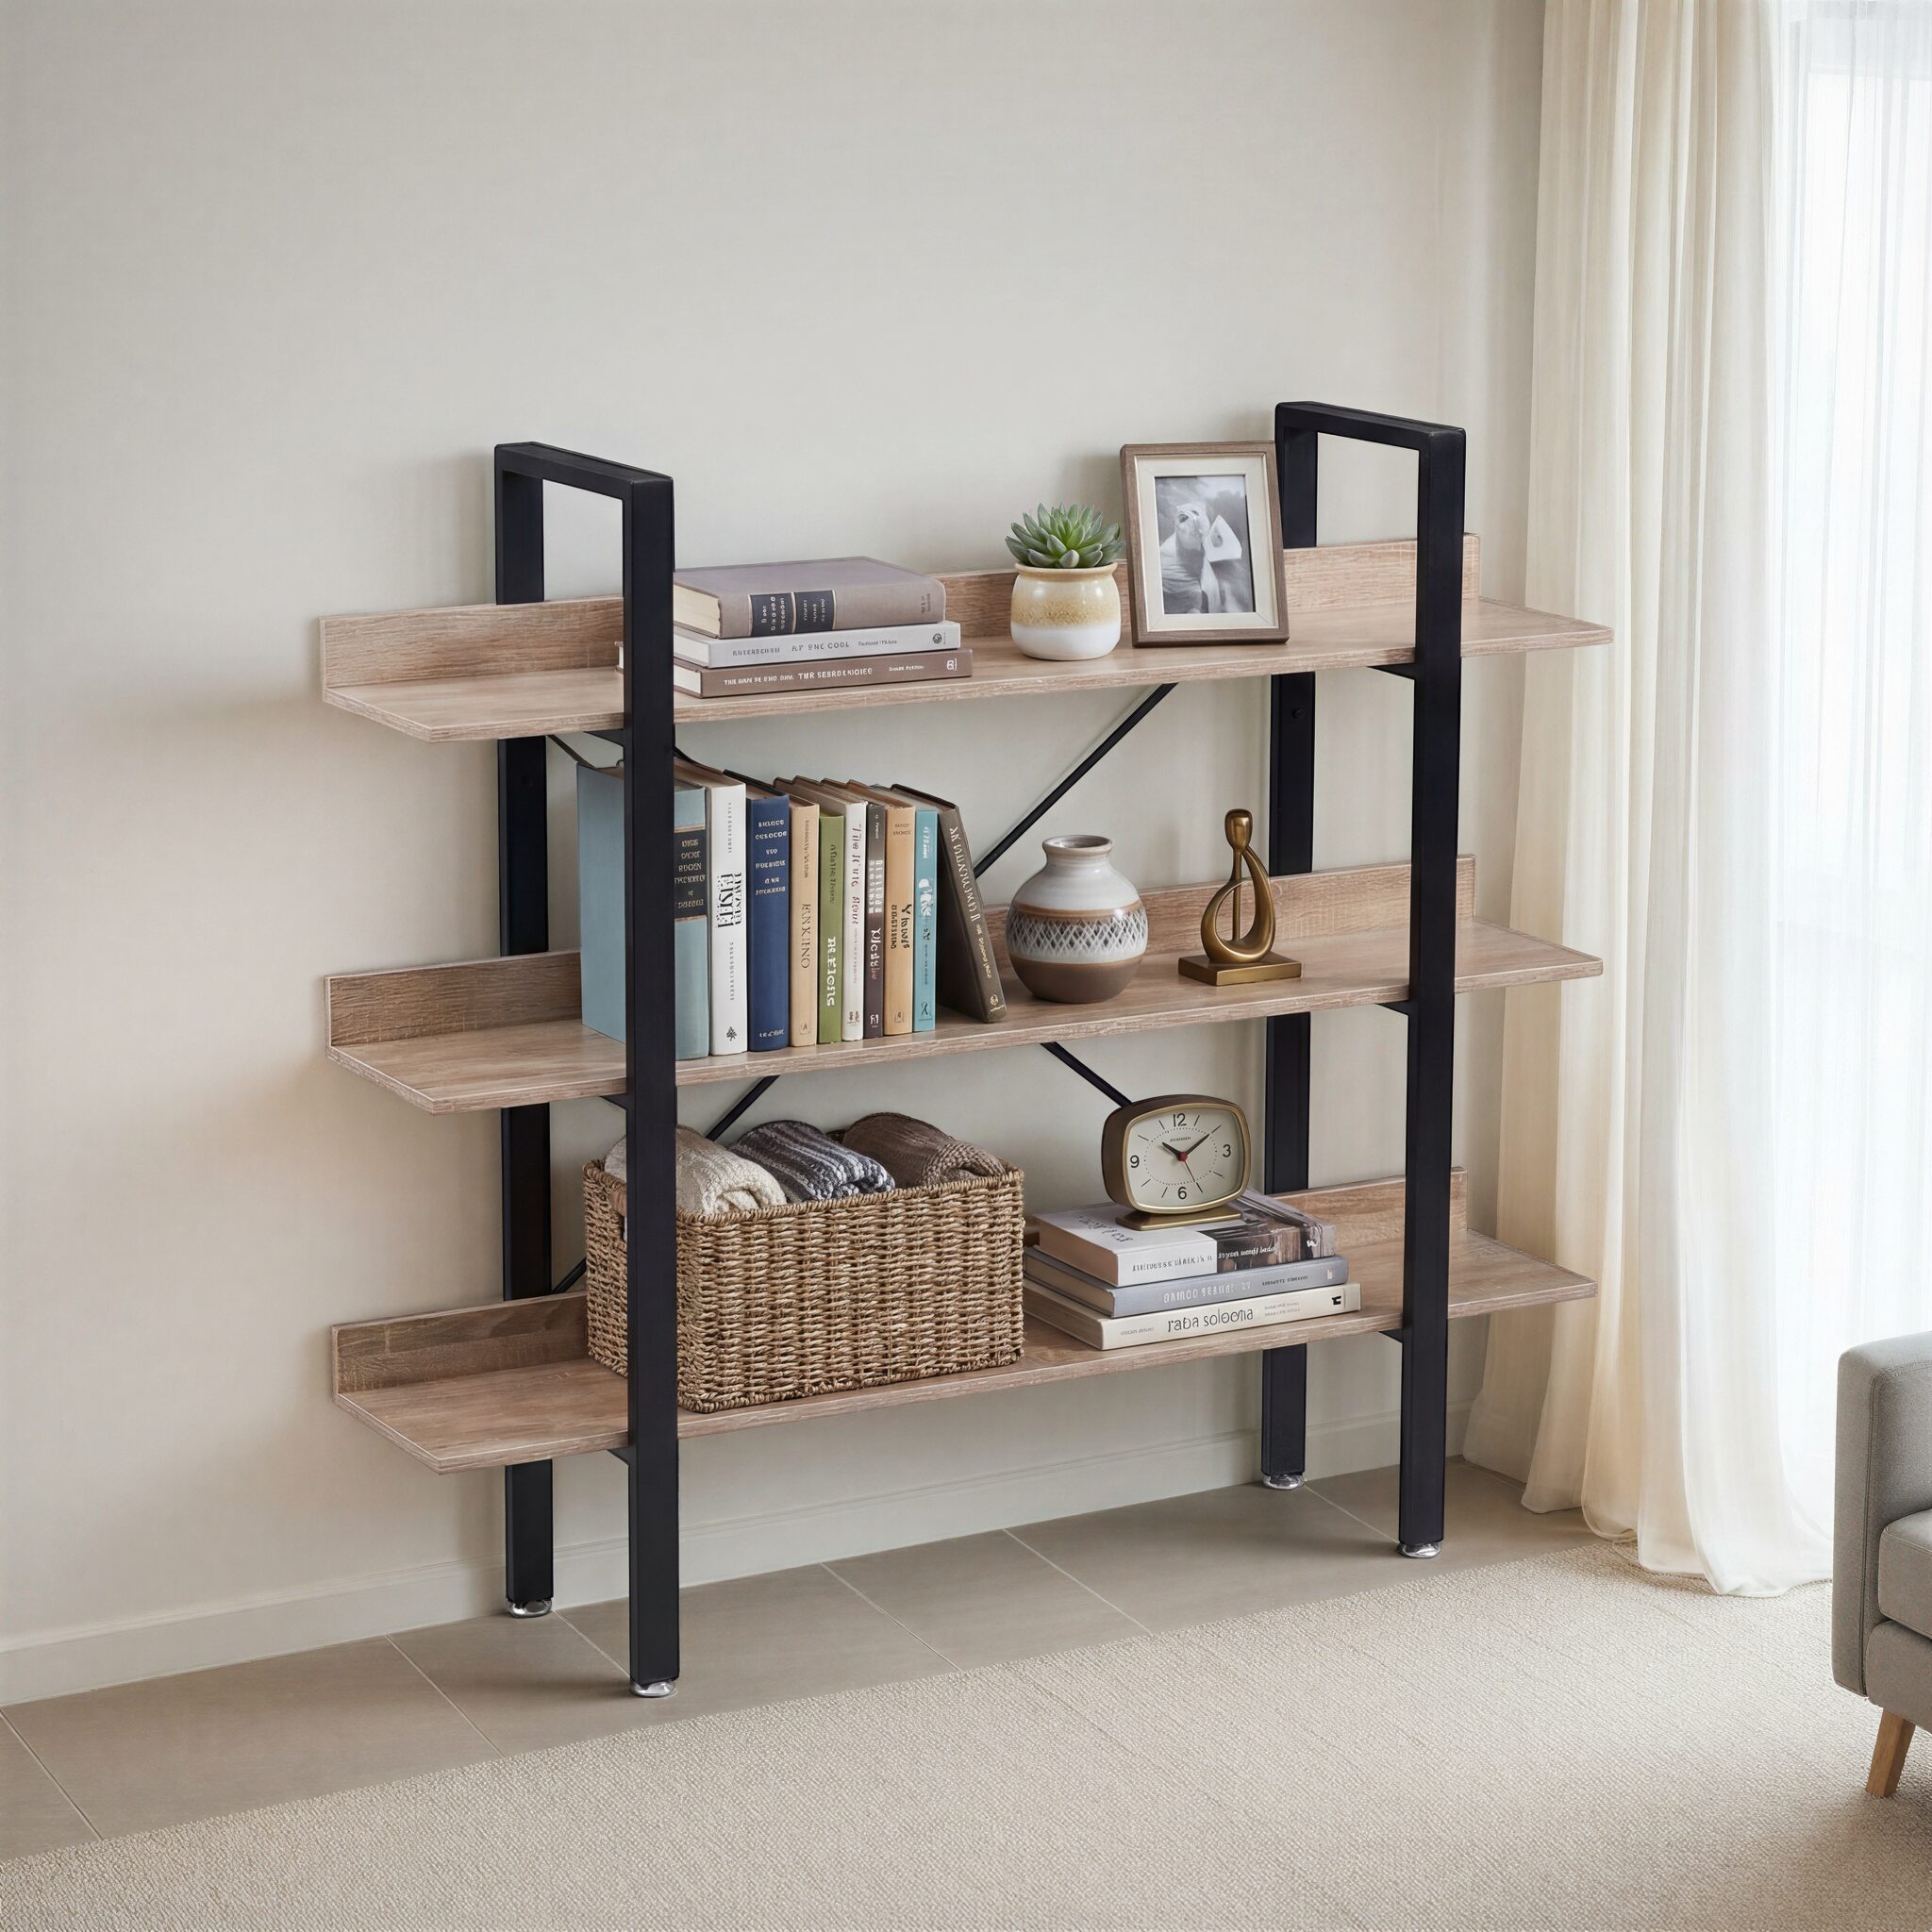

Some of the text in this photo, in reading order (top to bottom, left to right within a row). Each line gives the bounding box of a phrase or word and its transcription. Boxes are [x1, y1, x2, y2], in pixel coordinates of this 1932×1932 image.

[1173, 1112, 1188, 1127] 12
[1222, 1143, 1232, 1158] 3
[1129, 1155, 1140, 1169] 9
[1177, 1186, 1188, 1200] 6
